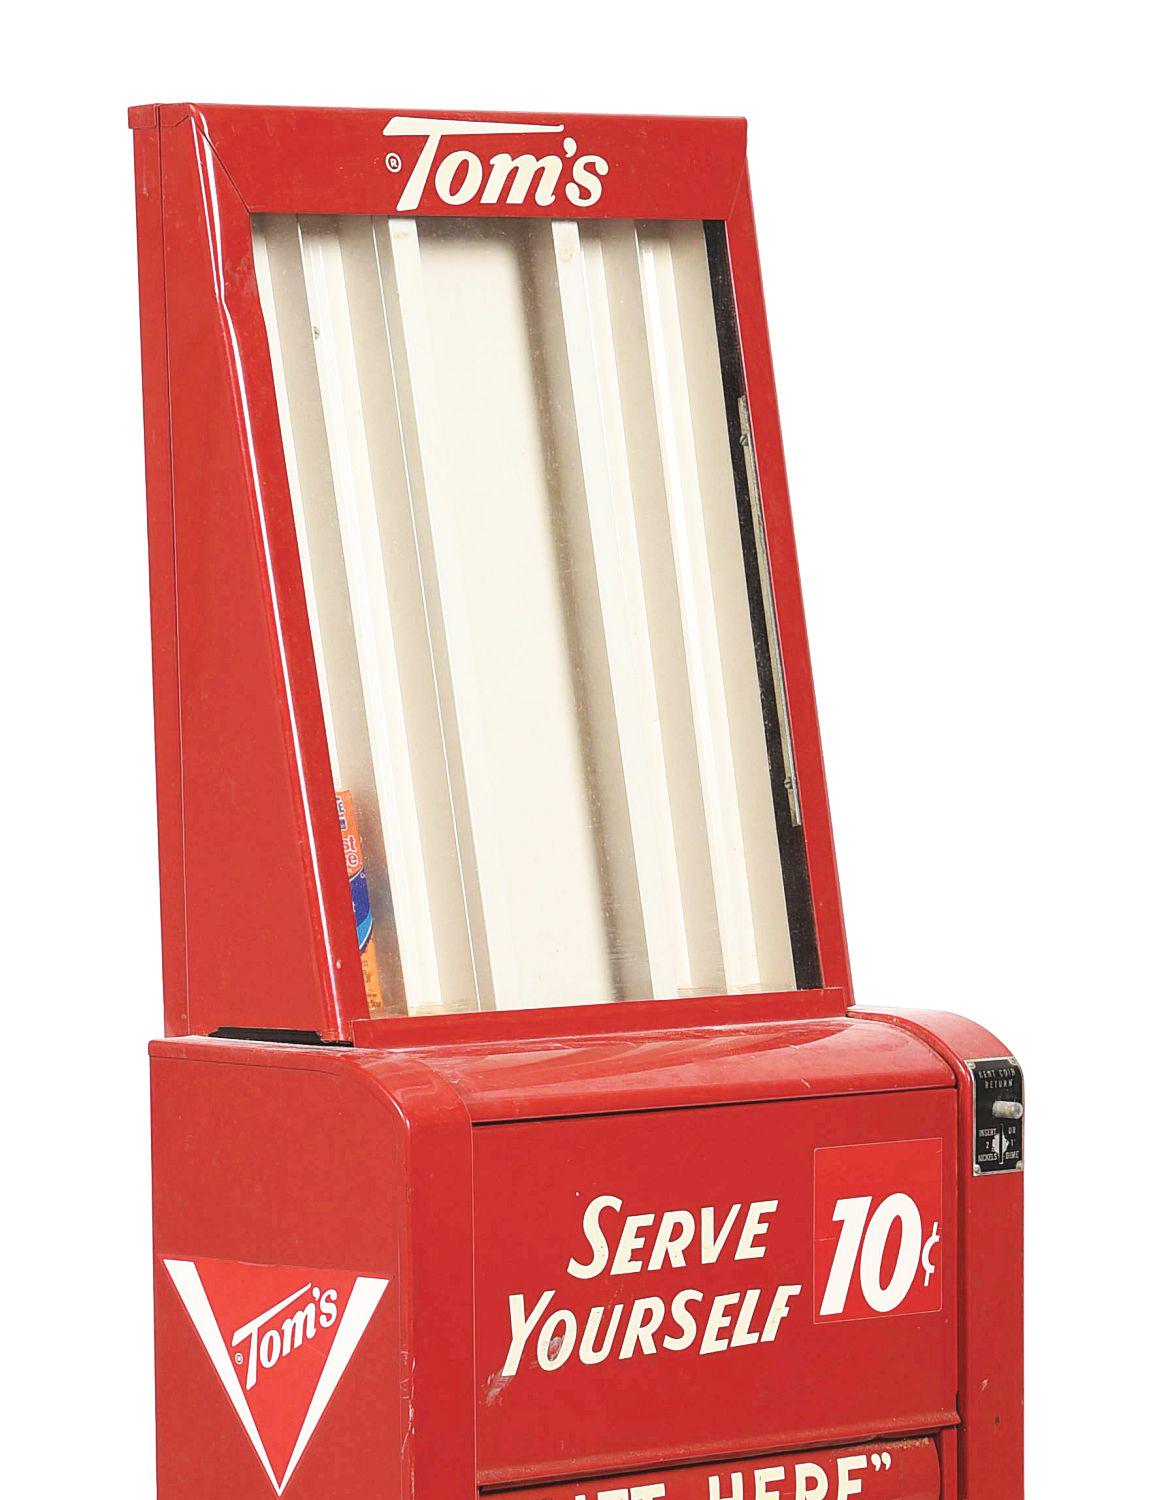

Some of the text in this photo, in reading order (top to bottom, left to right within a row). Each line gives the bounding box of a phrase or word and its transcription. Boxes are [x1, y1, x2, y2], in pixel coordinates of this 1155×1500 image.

[382, 116, 609, 212] Tom's
[978, 1127, 997, 1137] INSERT
[984, 1079, 1013, 1089] RETURN
[820, 1192, 940, 1316] 10¢
[231, 1282, 338, 1391] Tom's
